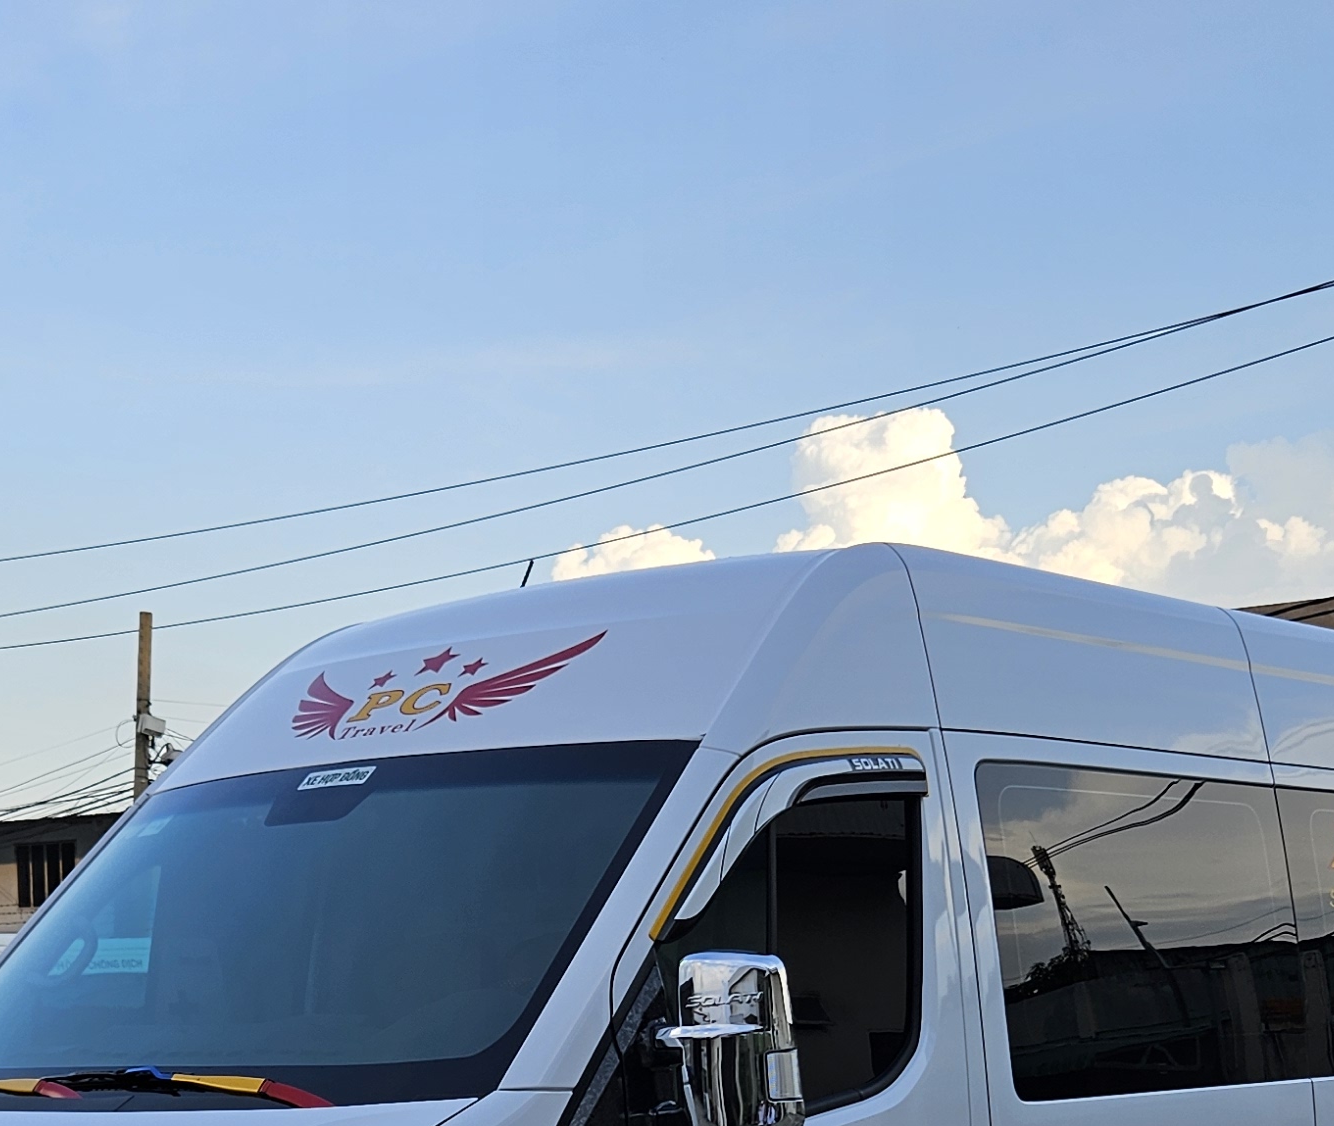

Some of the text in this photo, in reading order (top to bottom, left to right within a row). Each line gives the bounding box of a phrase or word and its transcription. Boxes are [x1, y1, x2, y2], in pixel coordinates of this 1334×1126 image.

[347, 683, 452, 723] PC
[338, 719, 417, 740] Travel
[854, 757, 900, 771] SOLATI
[303, 775, 320, 787] XE
